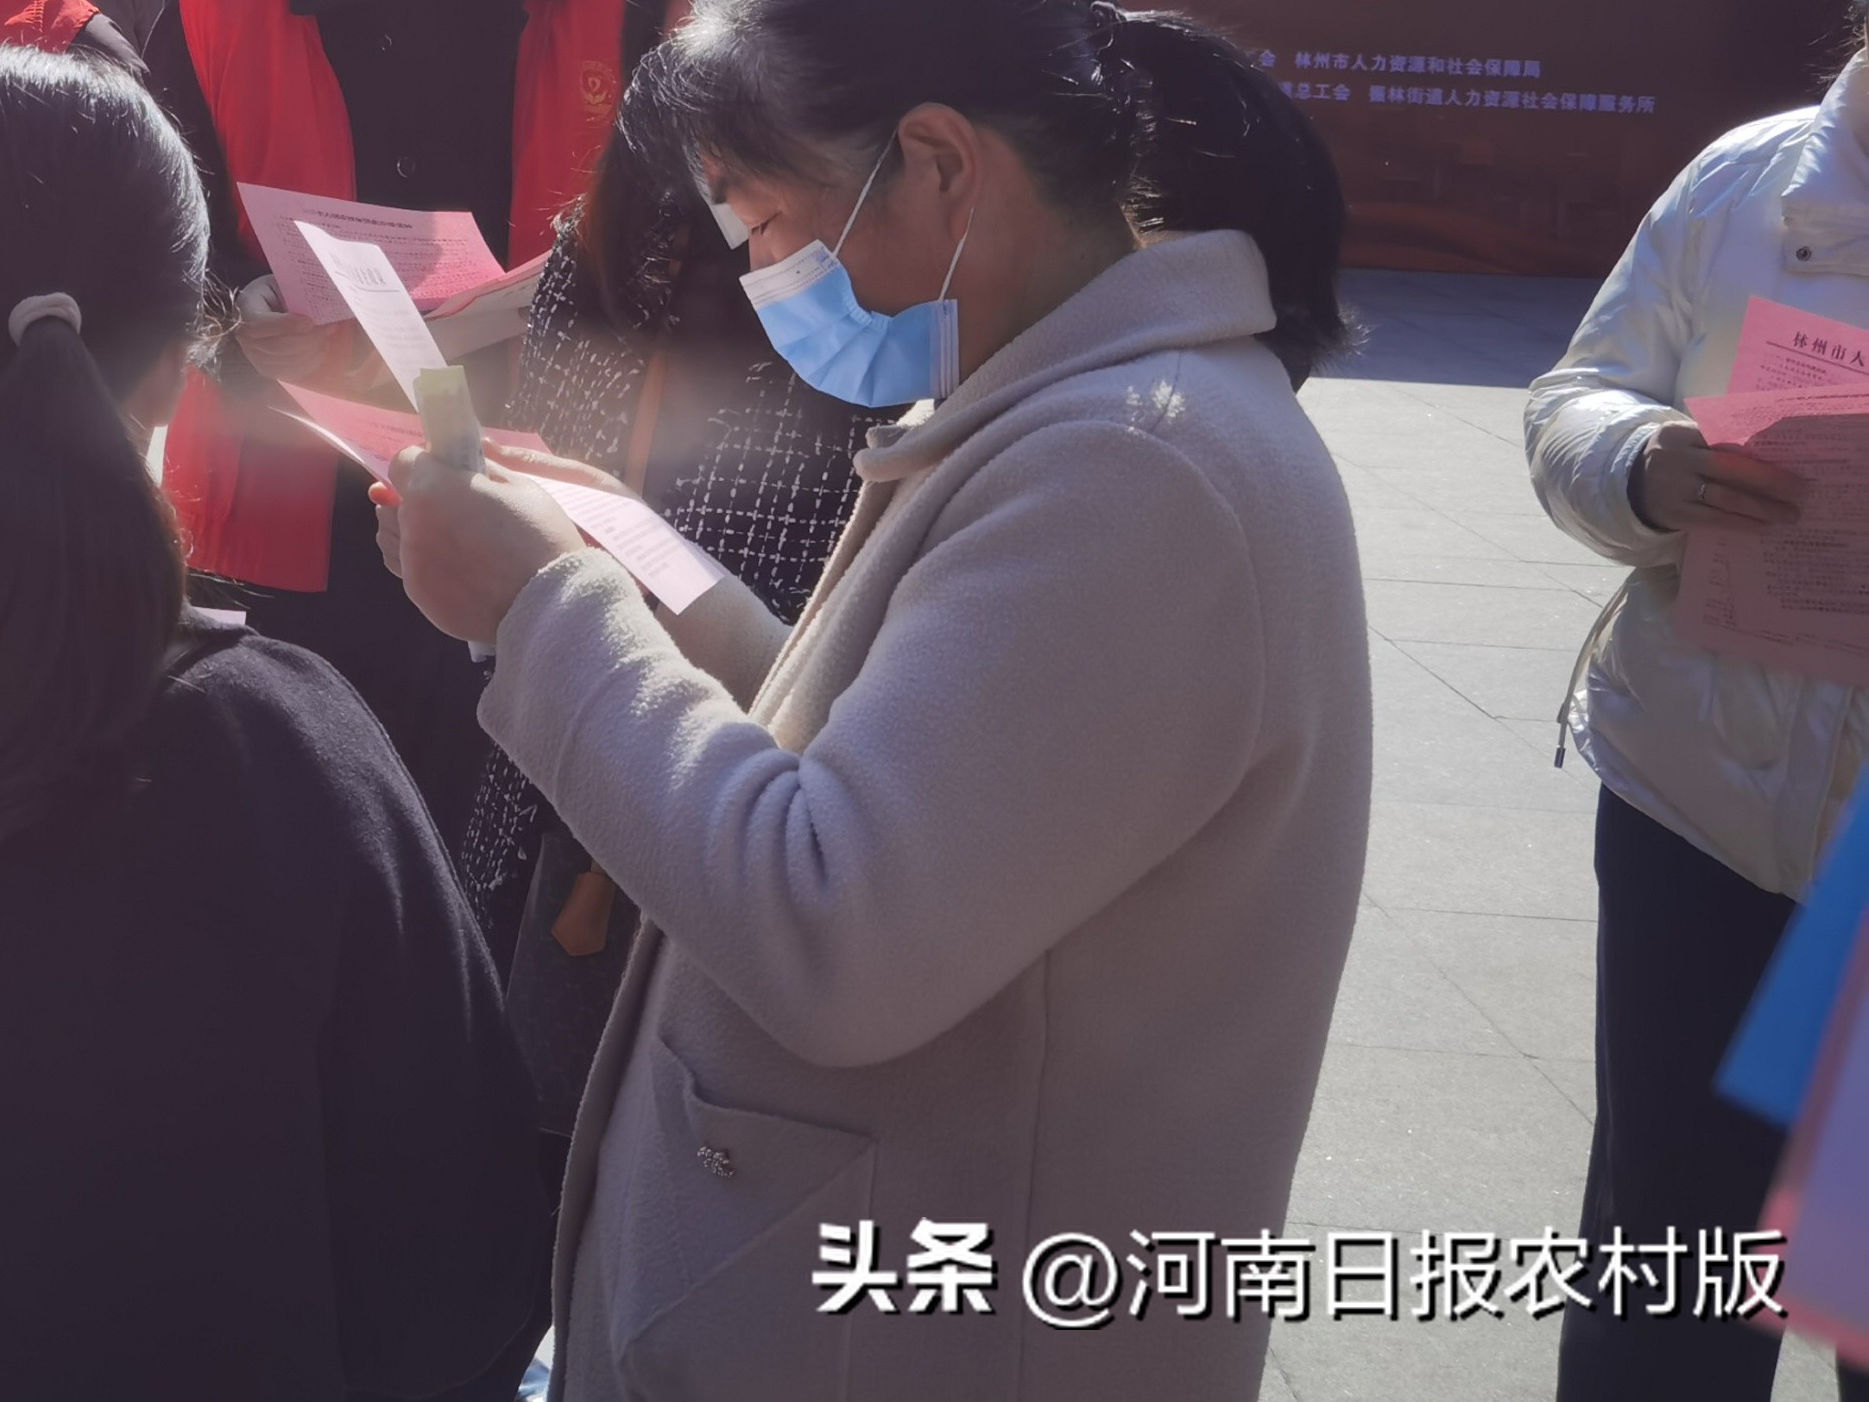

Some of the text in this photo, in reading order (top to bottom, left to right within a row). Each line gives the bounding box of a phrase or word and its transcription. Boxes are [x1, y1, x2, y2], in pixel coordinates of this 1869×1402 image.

[1295, 51, 1541, 79] 林州市人力资源和社会保障局
